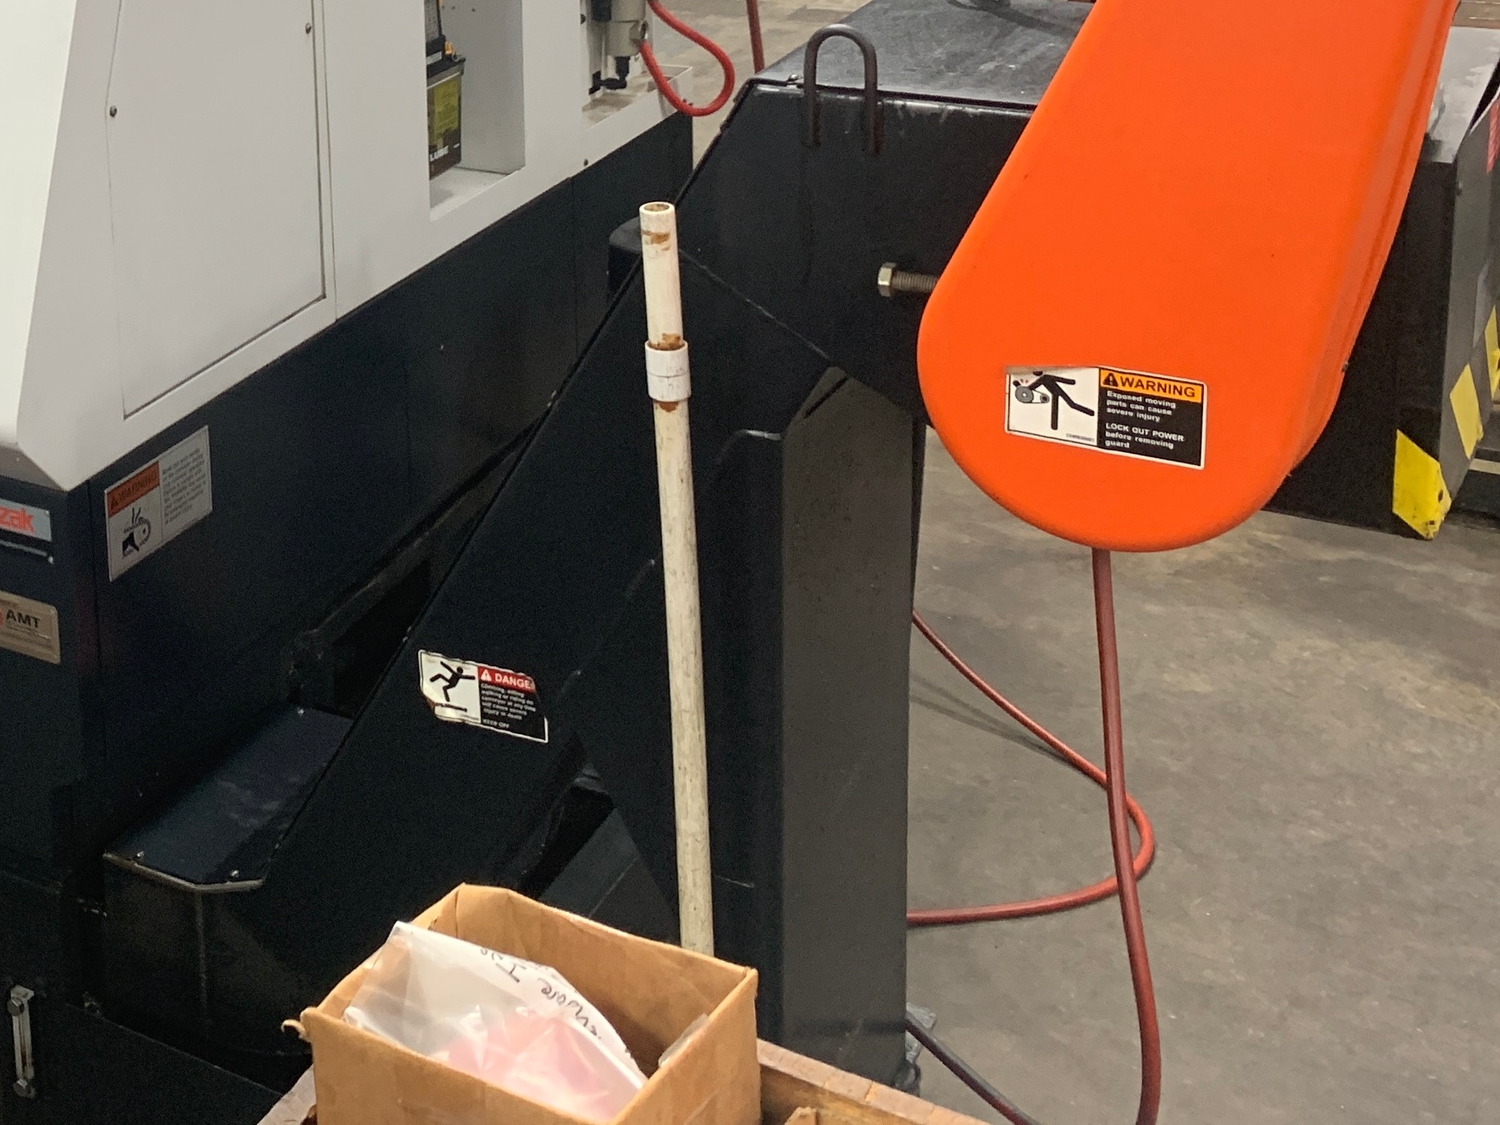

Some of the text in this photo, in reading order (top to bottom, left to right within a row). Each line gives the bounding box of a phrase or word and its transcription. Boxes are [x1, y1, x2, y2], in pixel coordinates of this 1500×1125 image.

[1119, 376, 1196, 398] WARNING
[1106, 390, 1176, 409] Exposed moving
[1106, 399, 1172, 416] parts can cause
[1106, 407, 1160, 423] severe injury
[1105, 422, 1185, 442] LOCK OUT POWER
[1105, 431, 1132, 441] before
[1134, 436, 1174, 450] removing
[1105, 440, 1130, 449] guard
[6, 609, 41, 629] AMT
[495, 673, 532, 689] DANGE
